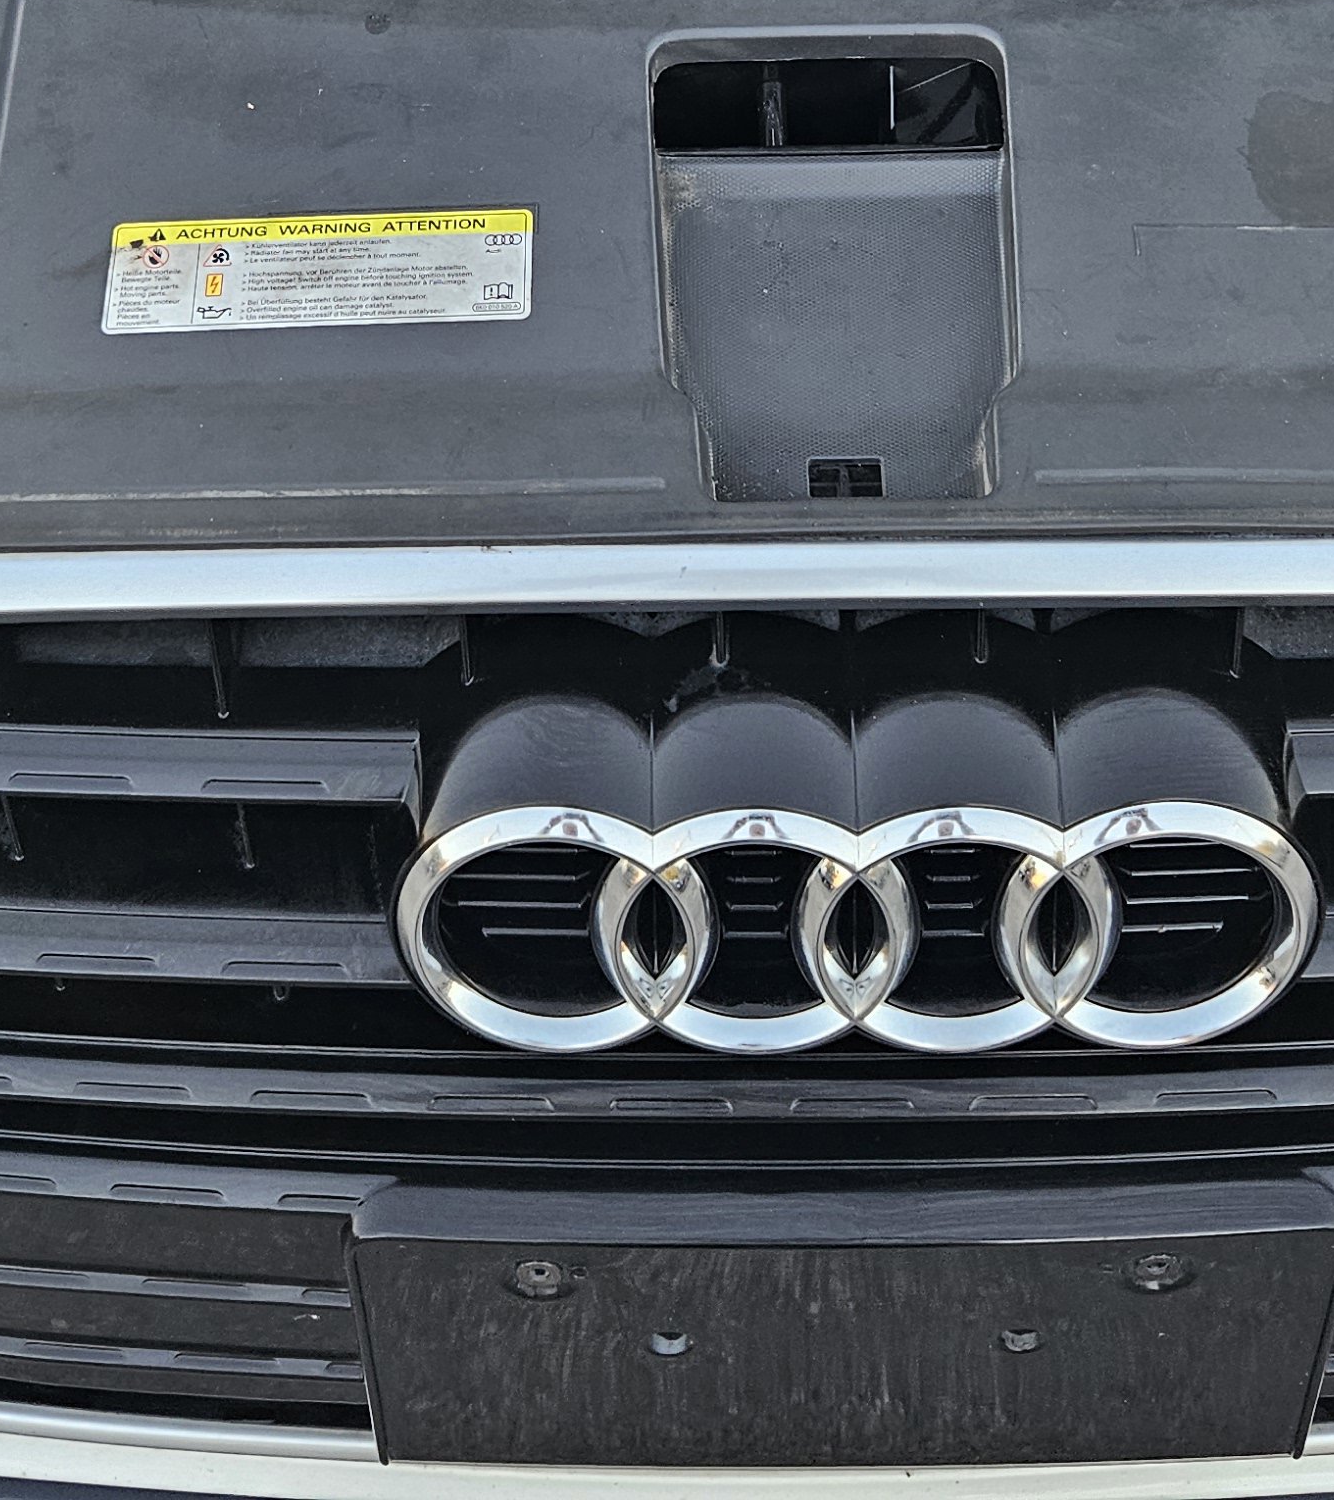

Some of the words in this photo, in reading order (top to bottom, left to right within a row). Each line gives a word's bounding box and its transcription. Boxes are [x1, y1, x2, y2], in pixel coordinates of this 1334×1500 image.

[176, 226, 267, 240] ACHTUNG
[279, 222, 372, 236] WARNING
[382, 218, 486, 233] ATTENTION
